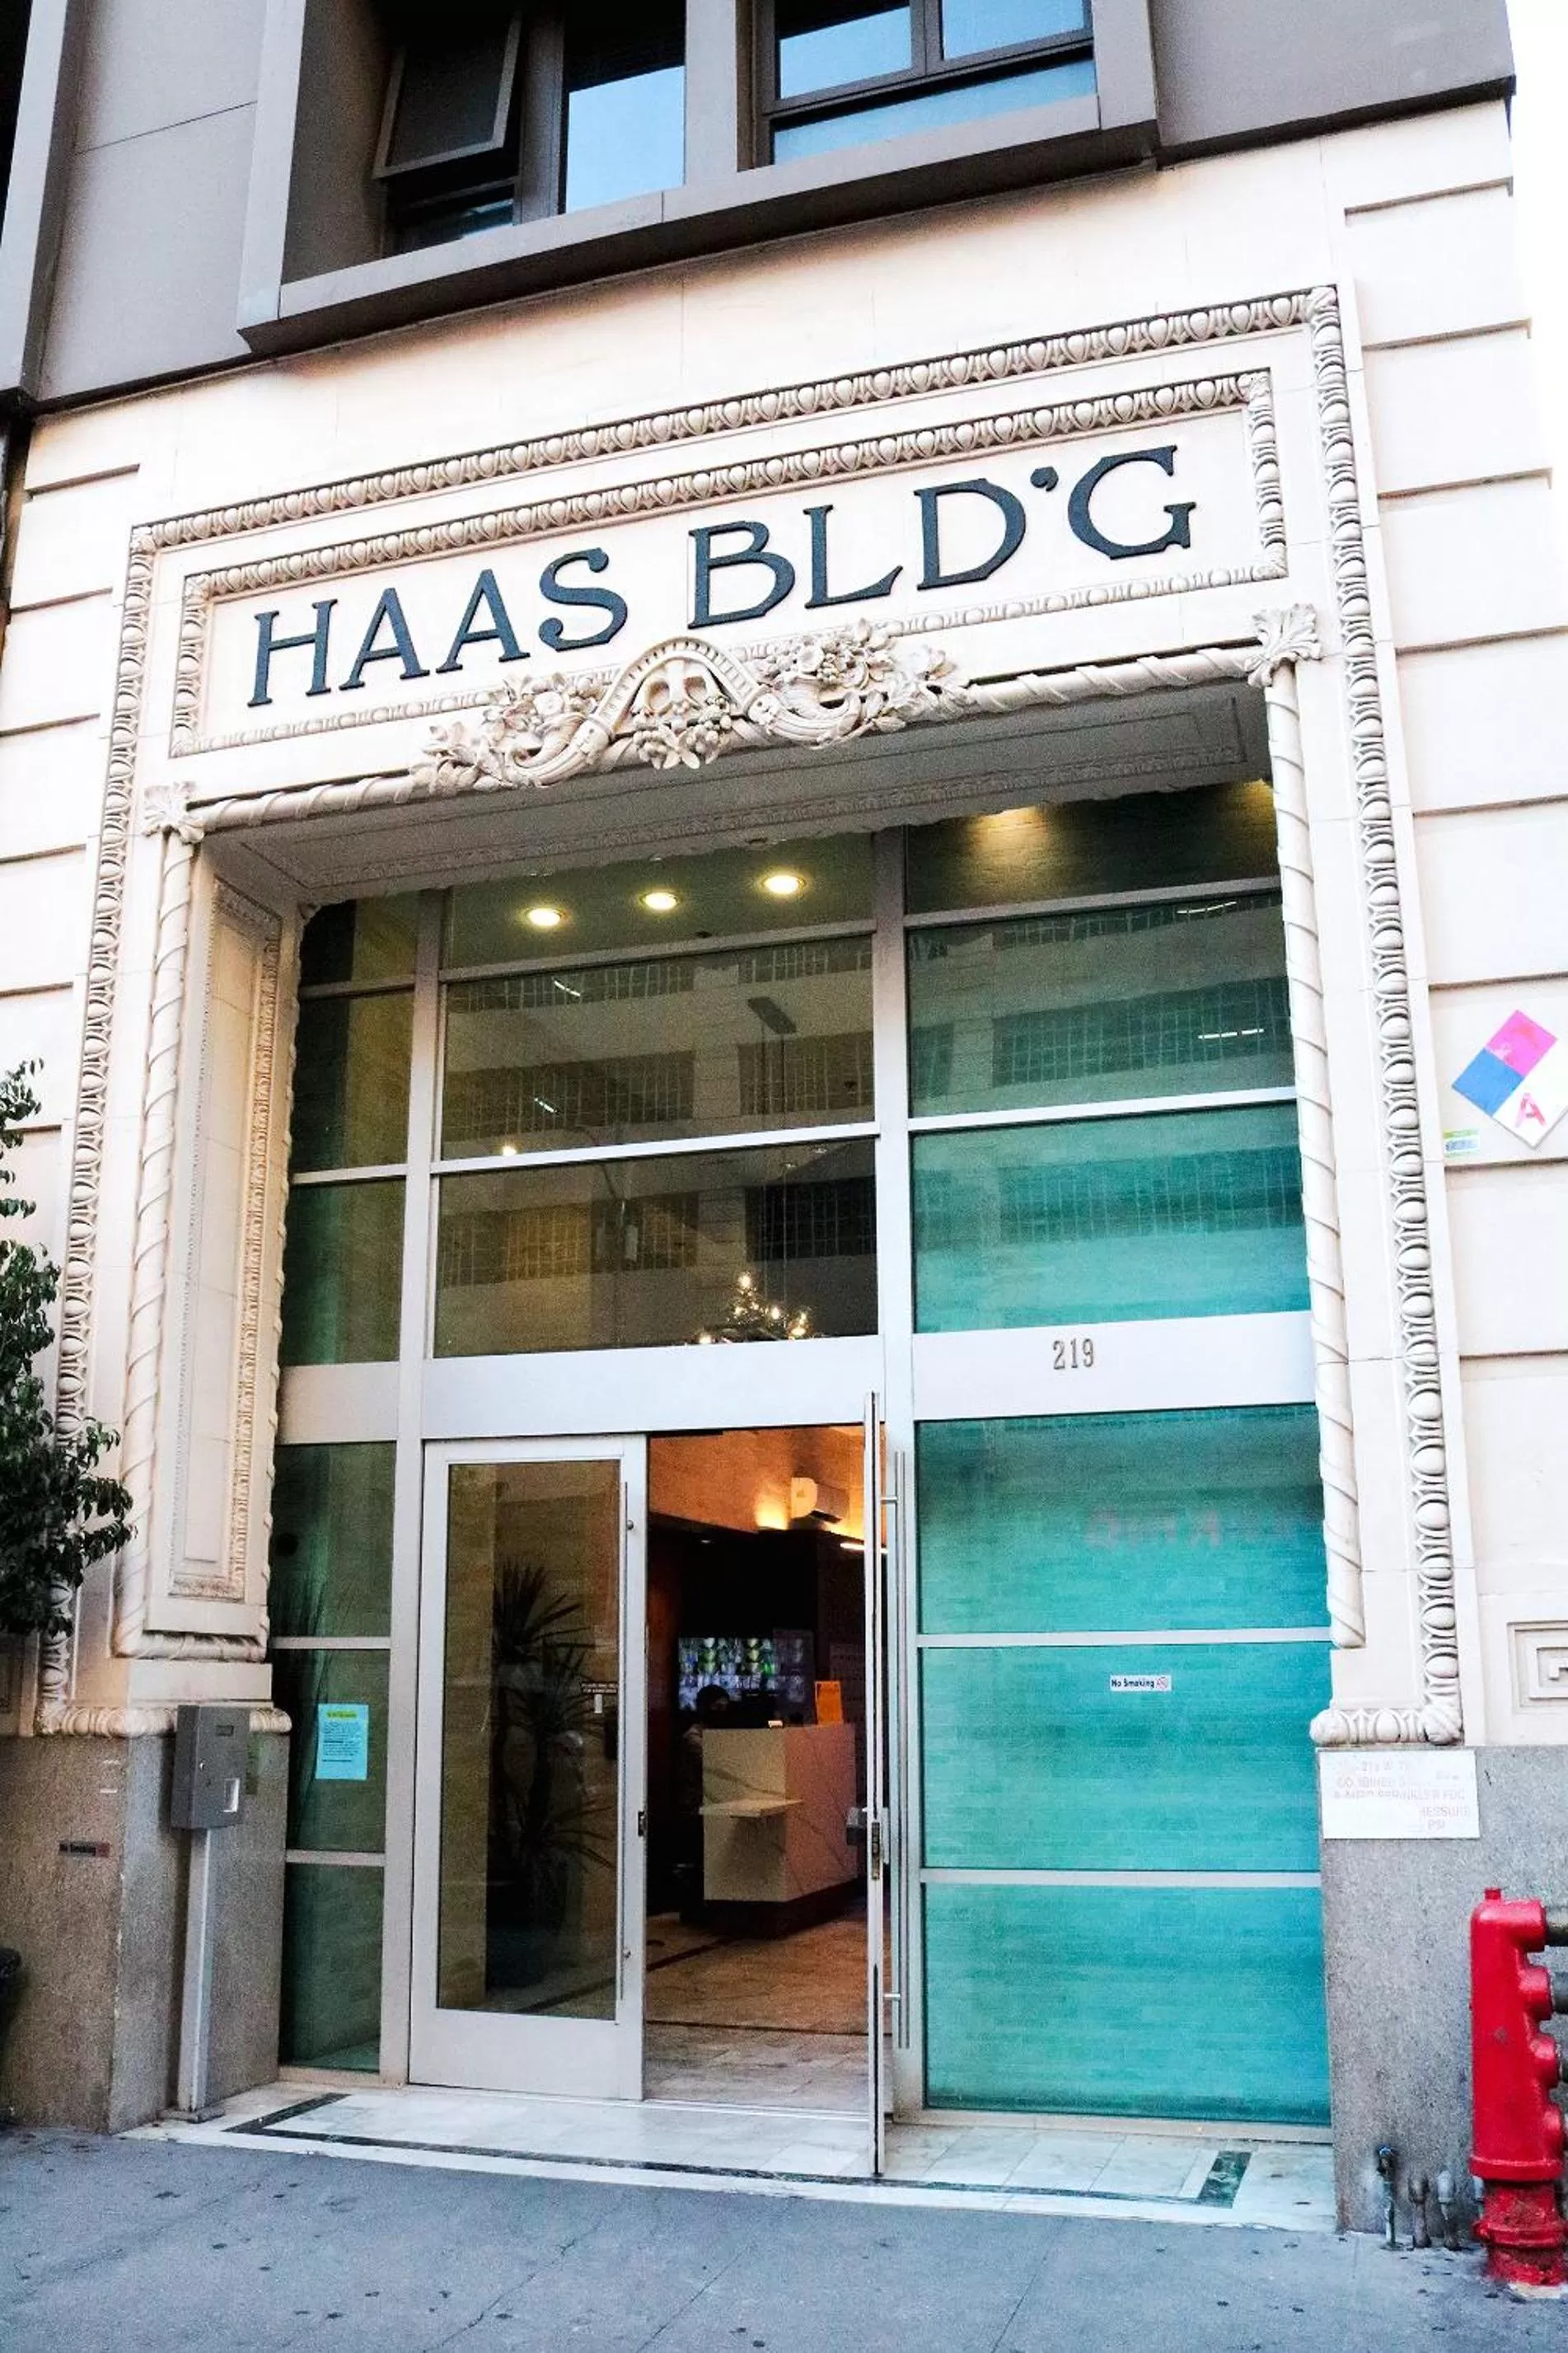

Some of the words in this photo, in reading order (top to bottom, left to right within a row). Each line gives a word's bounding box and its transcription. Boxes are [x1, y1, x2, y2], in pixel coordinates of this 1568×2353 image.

[247, 547, 629, 707] HAAS
[687, 444, 1196, 630] BLD'G
[1515, 1093, 1547, 1128] A
[1053, 1338, 1094, 1370] 219
[1111, 1679, 1121, 1688] No
[1123, 1678, 1154, 1689] Smoking
